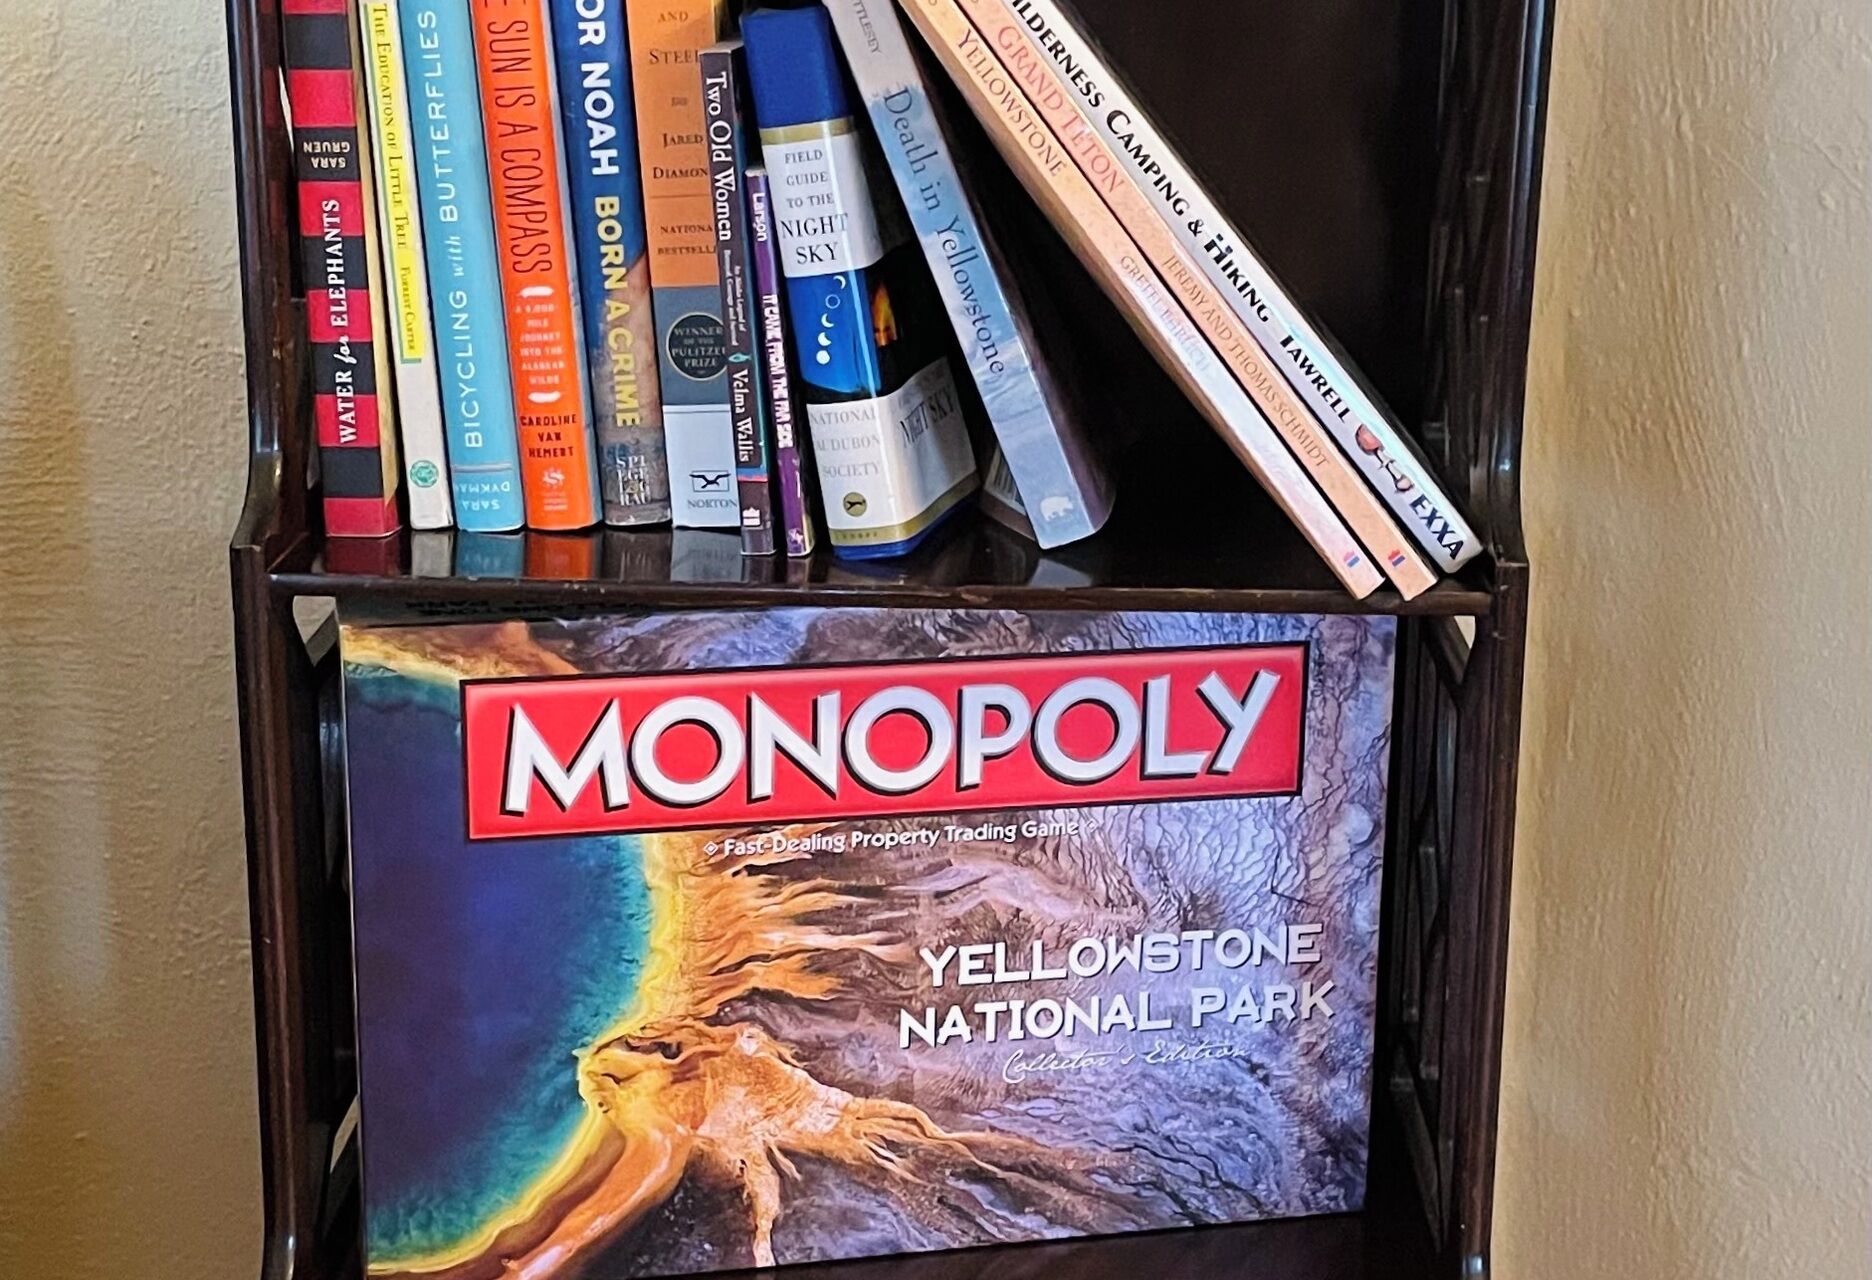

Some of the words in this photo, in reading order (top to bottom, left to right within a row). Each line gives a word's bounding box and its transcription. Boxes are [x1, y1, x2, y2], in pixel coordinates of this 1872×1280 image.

[373, 3, 388, 35] THE
[657, 11, 690, 23] AND
[487, 20, 533, 74] SUN
[376, 42, 395, 127] EDUCATION
[494, 86, 536, 109] IS
[706, 71, 728, 116] Two
[417, 10, 460, 223] BUTTERFLIES
[580, 62, 620, 176] NOAH
[956, 28, 1067, 178] YELLOWSTONE
[303, 141, 351, 153] GRUEN
[386, 131, 398, 151] OF
[497, 121, 539, 138] A
[662, 133, 704, 148] JARED
[709, 120, 733, 163] Old
[311, 157, 347, 169] SARA
[653, 167, 709, 180] DIAMON
[784, 148, 824, 165] FIELD
[388, 155, 405, 209] LITTLE
[786, 170, 829, 187] GUIDE
[500, 148, 553, 274] COMPASS
[714, 166, 736, 242] Women
[752, 192, 767, 242] Larson
[786, 196, 804, 209] TO
[806, 191, 835, 207] THE
[394, 214, 410, 249] TREE
[594, 195, 629, 291] BORN
[660, 224, 714, 235] NATIONA
[780, 211, 849, 240] NIGHT
[883, 86, 939, 176] Death
[920, 182, 941, 212] in
[936, 214, 1005, 376] Yellowstone
[322, 199, 350, 328] ELEPHANTS
[445, 236, 465, 277] with
[796, 240, 839, 265] SKY
[997, 25, 1064, 111] GRAND
[1061, 108, 1125, 194] TETON
[1162, 255, 1208, 307] JEREMY
[1202, 308, 1234, 343] AND
[1227, 337, 1278, 405] THOMAS
[1272, 400, 1330, 468] SCHMIDT
[605, 298, 631, 321] A
[674, 326, 724, 336] WINNER
[1106, 108, 1190, 218] CAMPING
[1186, 217, 1205, 239] &
[1203, 233, 1272, 324] HIKING
[1279, 333, 1351, 425] TAWRELL
[1409, 493, 1466, 561] EXXA
[333, 335, 358, 365] for
[765, 341, 787, 375] FROM
[448, 290, 483, 449] BICYCLING
[607, 326, 641, 428] CRIME
[731, 368, 749, 414] Velma
[771, 376, 789, 400] THE
[339, 370, 358, 445] WATER
[520, 414, 577, 427] CAROLINE
[528, 445, 575, 458] HEMERT
[537, 432, 562, 442] VAN
[736, 416, 755, 463] Wallis
[776, 422, 794, 449] SIDE
[462, 499, 501, 511] SARA
[687, 498, 738, 510] NORTON
[502, 668, 1282, 817] MONOPOLY
[723, 831, 845, 857] Fast-Dealing
[851, 826, 941, 851] Property
[944, 822, 1016, 845] Trading
[1021, 819, 1079, 839] Game
[919, 922, 1324, 987] YELLOWSTONE
[899, 989, 1173, 1049] NATIONAL
[1191, 979, 1336, 1028] PARK
[1002, 1042, 1137, 1084] Collector's
[1144, 1038, 1253, 1067] Edition
